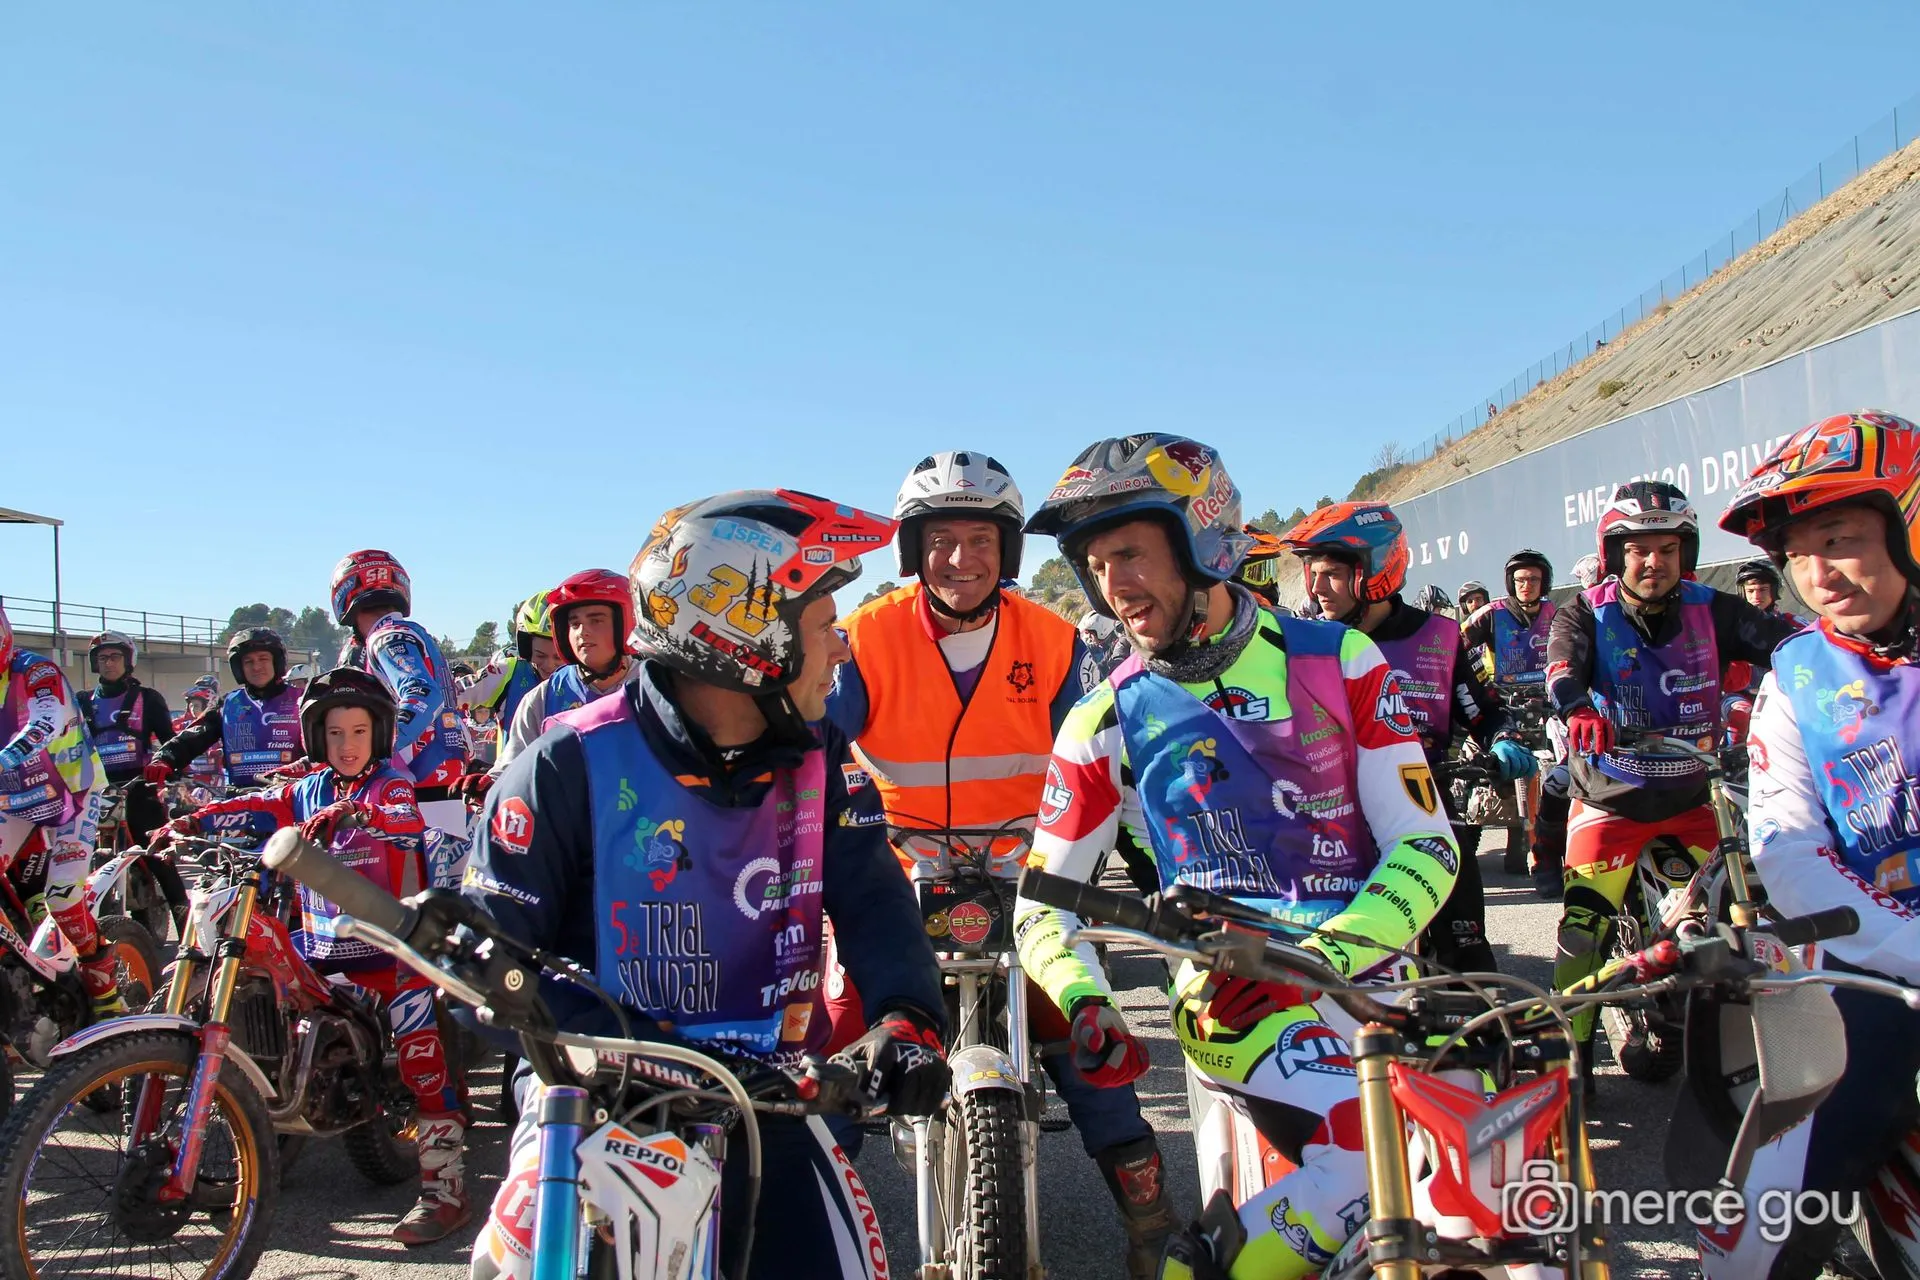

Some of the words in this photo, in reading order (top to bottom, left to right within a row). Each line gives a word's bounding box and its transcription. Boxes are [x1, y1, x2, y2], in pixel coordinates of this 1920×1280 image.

[1047, 484, 1092, 501] Bull
[1109, 477, 1151, 494] AIROH
[945, 495, 984, 503] hebo
[821, 532, 881, 543] hebo
[804, 548, 833, 562] 100%
[1399, 690, 1446, 700] ARCMOTOR
[1679, 701, 1703, 715] fcm
[272, 728, 289, 736] fcm
[267, 741, 295, 749] TrialGo
[483, 879, 540, 905] MICHELIN
[1381, 885, 1413, 918] riello
[951, 917, 988, 927] BSC
[0, 925, 28, 957] EPSOL
[604, 1138, 687, 1177] REPSOL
